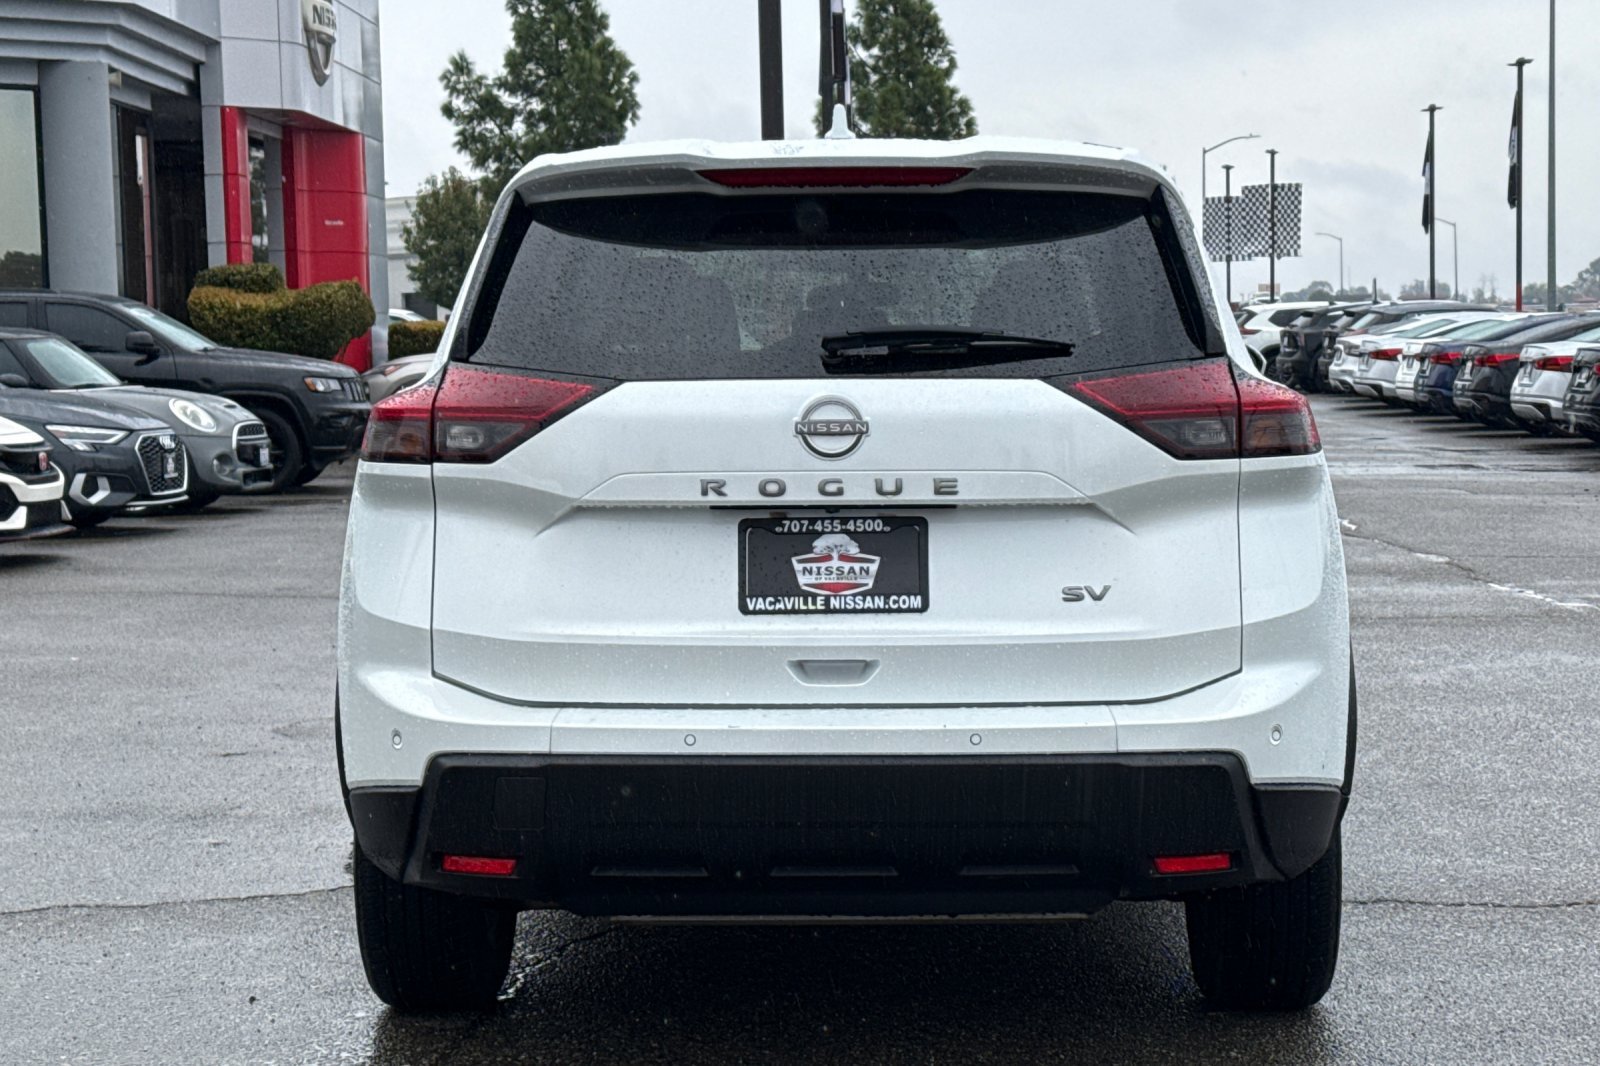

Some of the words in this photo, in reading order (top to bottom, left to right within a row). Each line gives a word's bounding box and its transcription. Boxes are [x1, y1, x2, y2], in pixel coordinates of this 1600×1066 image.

[797, 423, 867, 432] NISSAN
[700, 478, 959, 497] ROGUE
[802, 566, 870, 576] NISSAN
[1061, 585, 1112, 602] SV
[746, 596, 825, 610] VACAVILLE
[830, 595, 922, 609] NISSAN.COM
